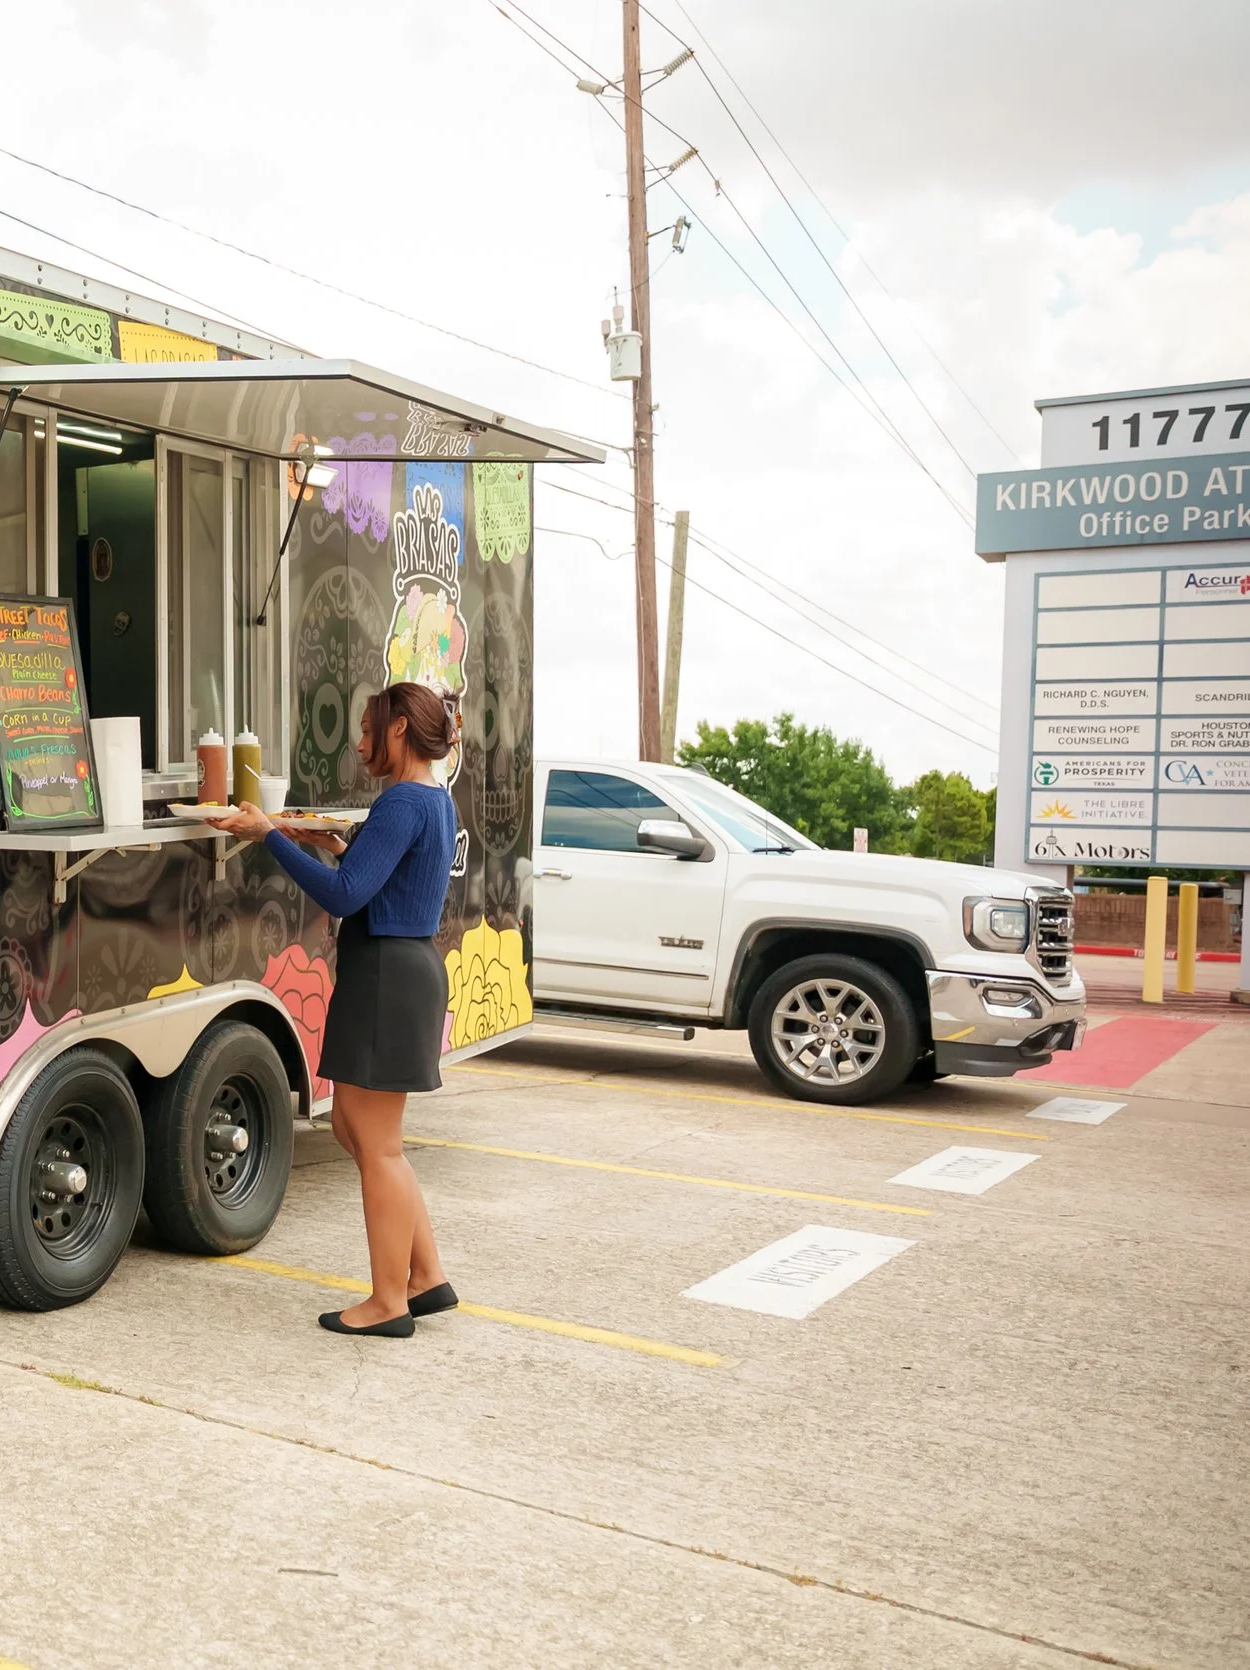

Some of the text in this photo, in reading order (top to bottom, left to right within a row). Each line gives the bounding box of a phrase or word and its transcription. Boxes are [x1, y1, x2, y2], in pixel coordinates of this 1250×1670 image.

[996, 470, 1189, 511] KIRKWOOD
[416, 490, 440, 522] LAS
[1079, 503, 1250, 538] Office Park
[396, 521, 458, 582] BRASAS
[38, 684, 72, 702] Beans
[1043, 689, 1149, 699] RICHARD C. NGUYEN,
[1080, 700, 1109, 708] D.D.S.
[1049, 725, 1140, 734] RENEWING HOPE
[1170, 731, 1213, 739] SPORTS
[1217, 731, 1224, 739] &
[1058, 737, 1129, 745] COUNSELING
[1191, 740, 1216, 748] RON
[1064, 768, 1146, 776] PROSPERITY
[1084, 800, 1146, 808] THE LIBRE
[1074, 841, 1150, 860] Motors
